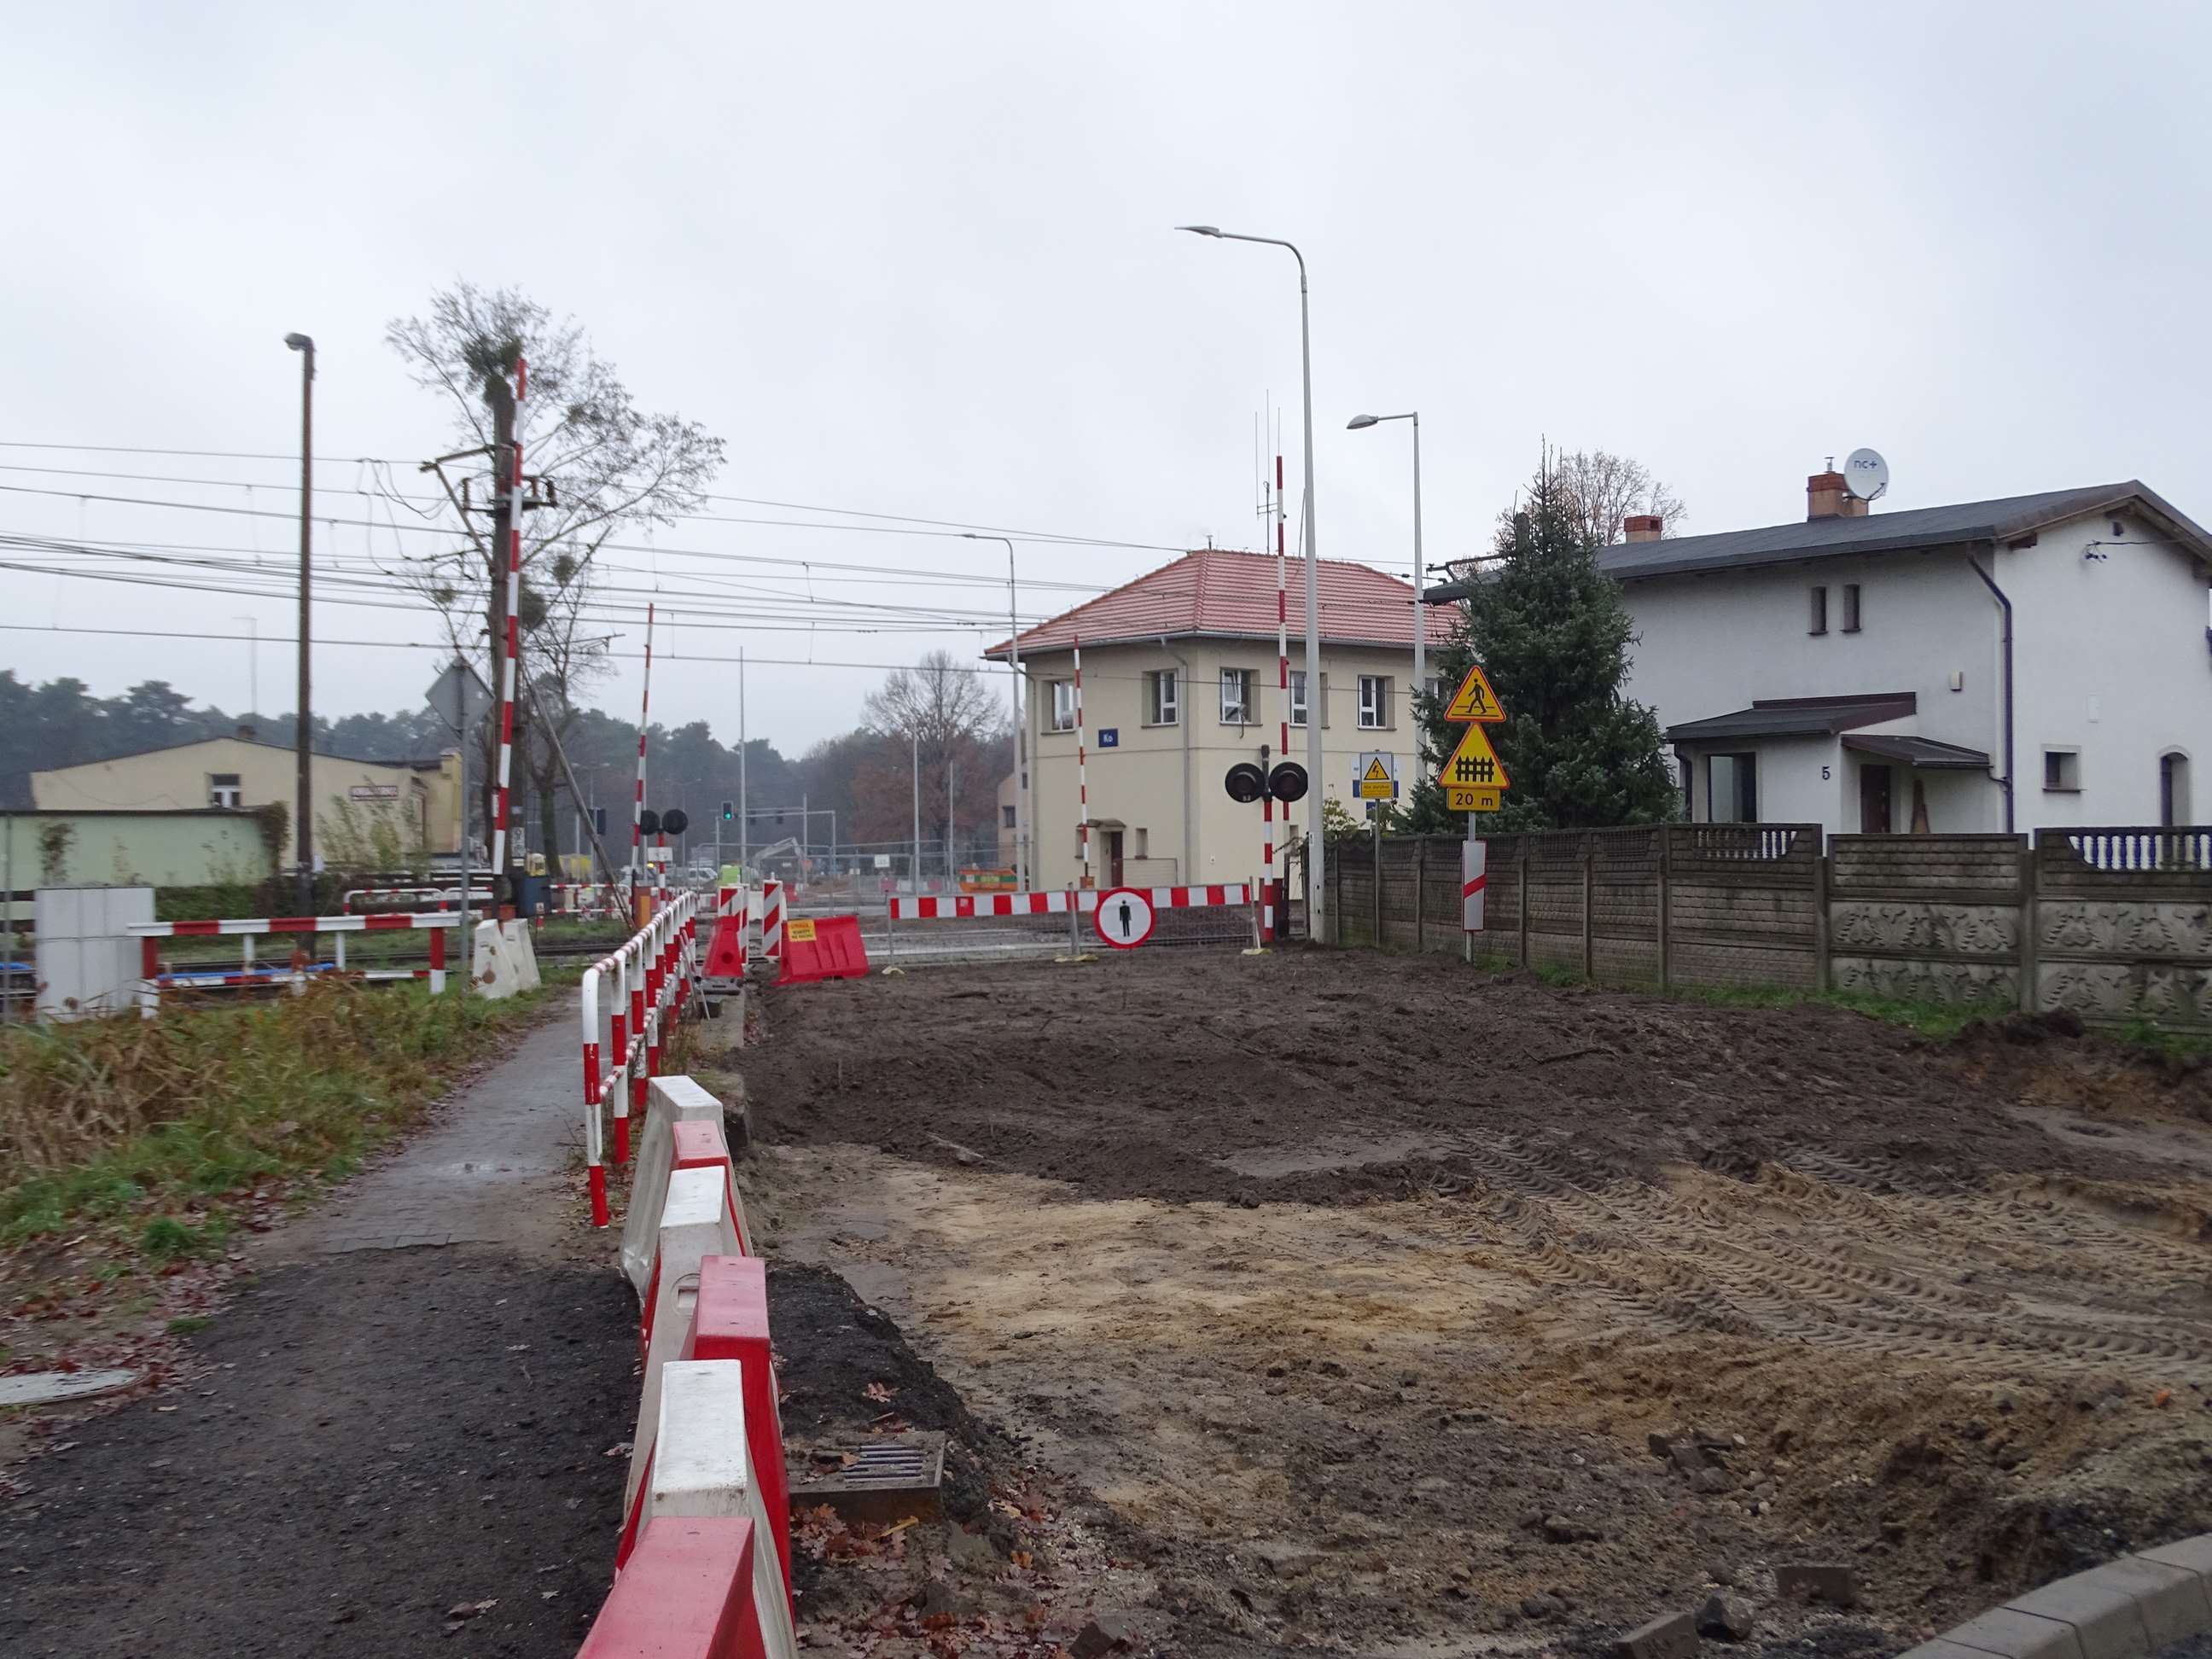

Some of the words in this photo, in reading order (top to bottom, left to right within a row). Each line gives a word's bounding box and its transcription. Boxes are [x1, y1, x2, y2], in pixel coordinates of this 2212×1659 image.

[1854, 460, 1877, 469] nc+
[1822, 765, 1831, 780] 5
[1455, 793, 1474, 806] 20
[1481, 797, 1493, 806] m
